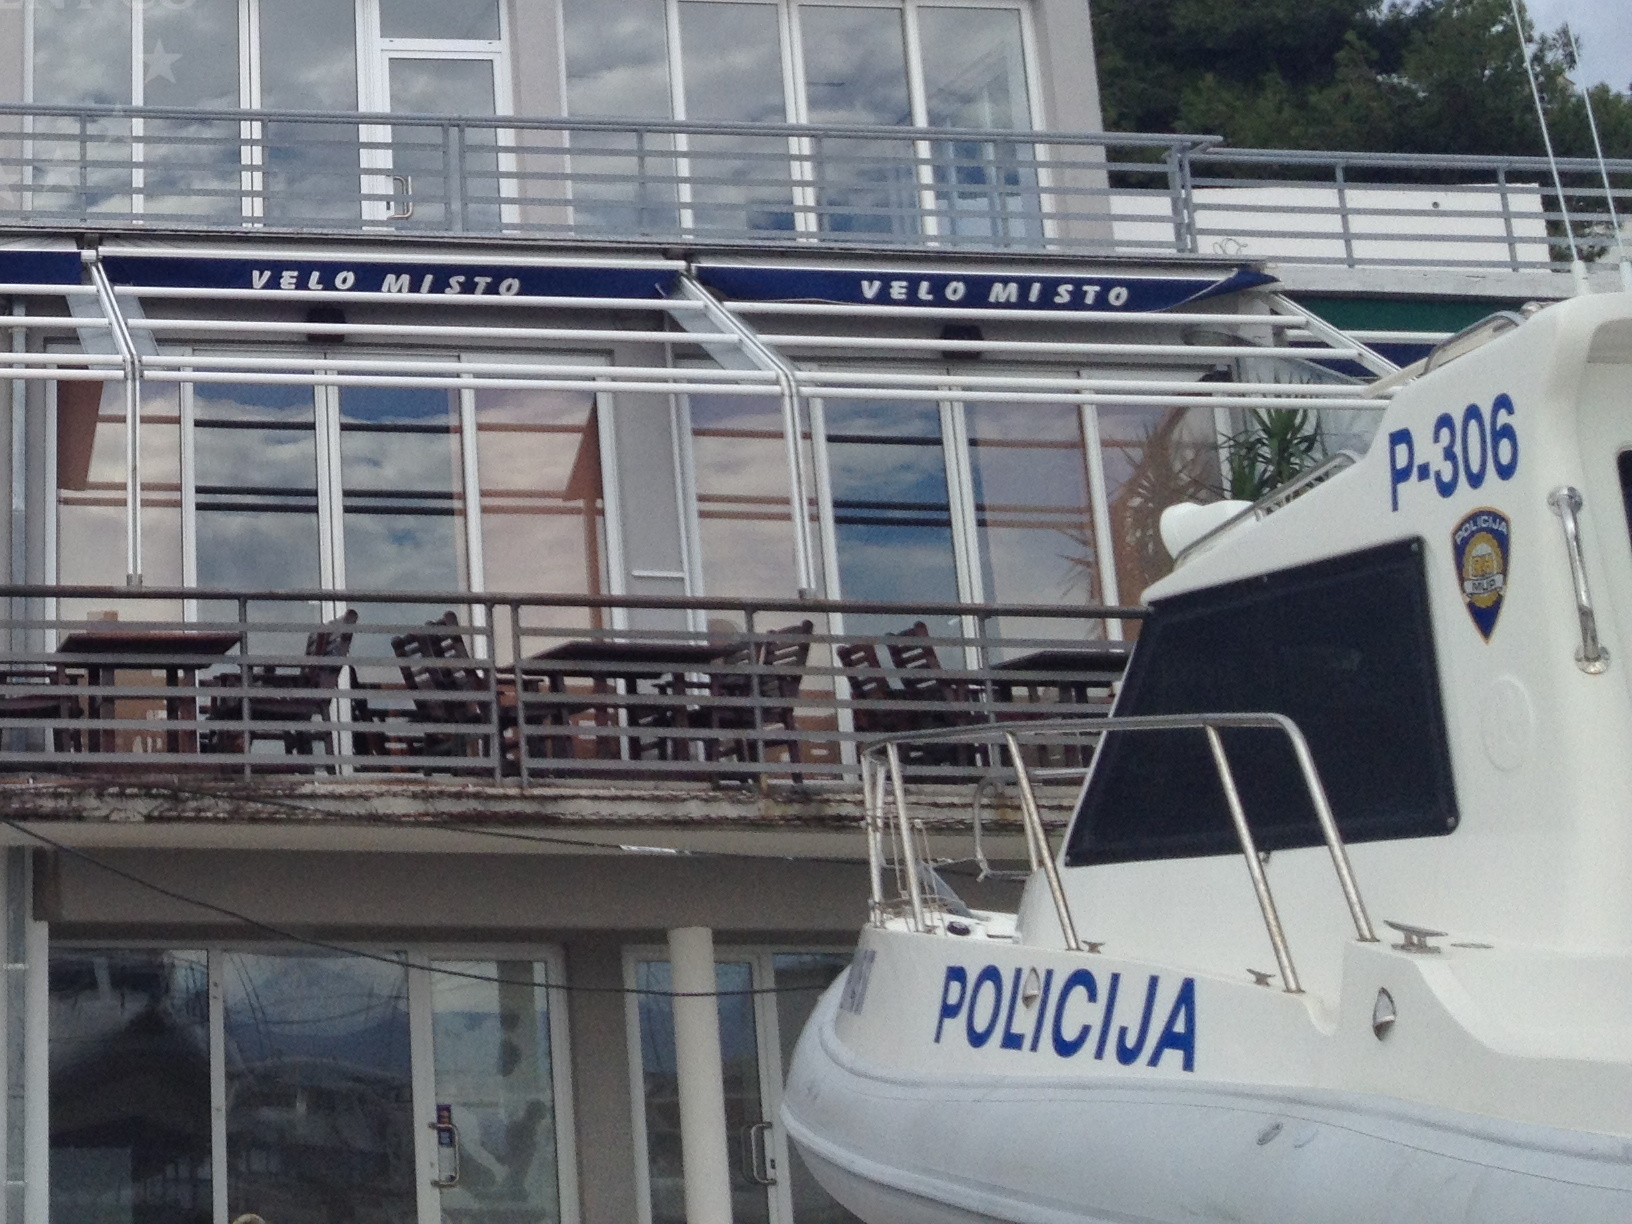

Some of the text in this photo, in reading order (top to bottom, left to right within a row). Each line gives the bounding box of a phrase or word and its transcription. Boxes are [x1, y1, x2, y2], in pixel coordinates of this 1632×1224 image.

[252, 270, 521, 296] VELO MISTO
[861, 280, 1129, 306] VELO MISTO
[1388, 392, 1519, 513] P-306
[1454, 515, 1508, 545] POLICIJA
[933, 964, 1197, 1073] POLICIJA
